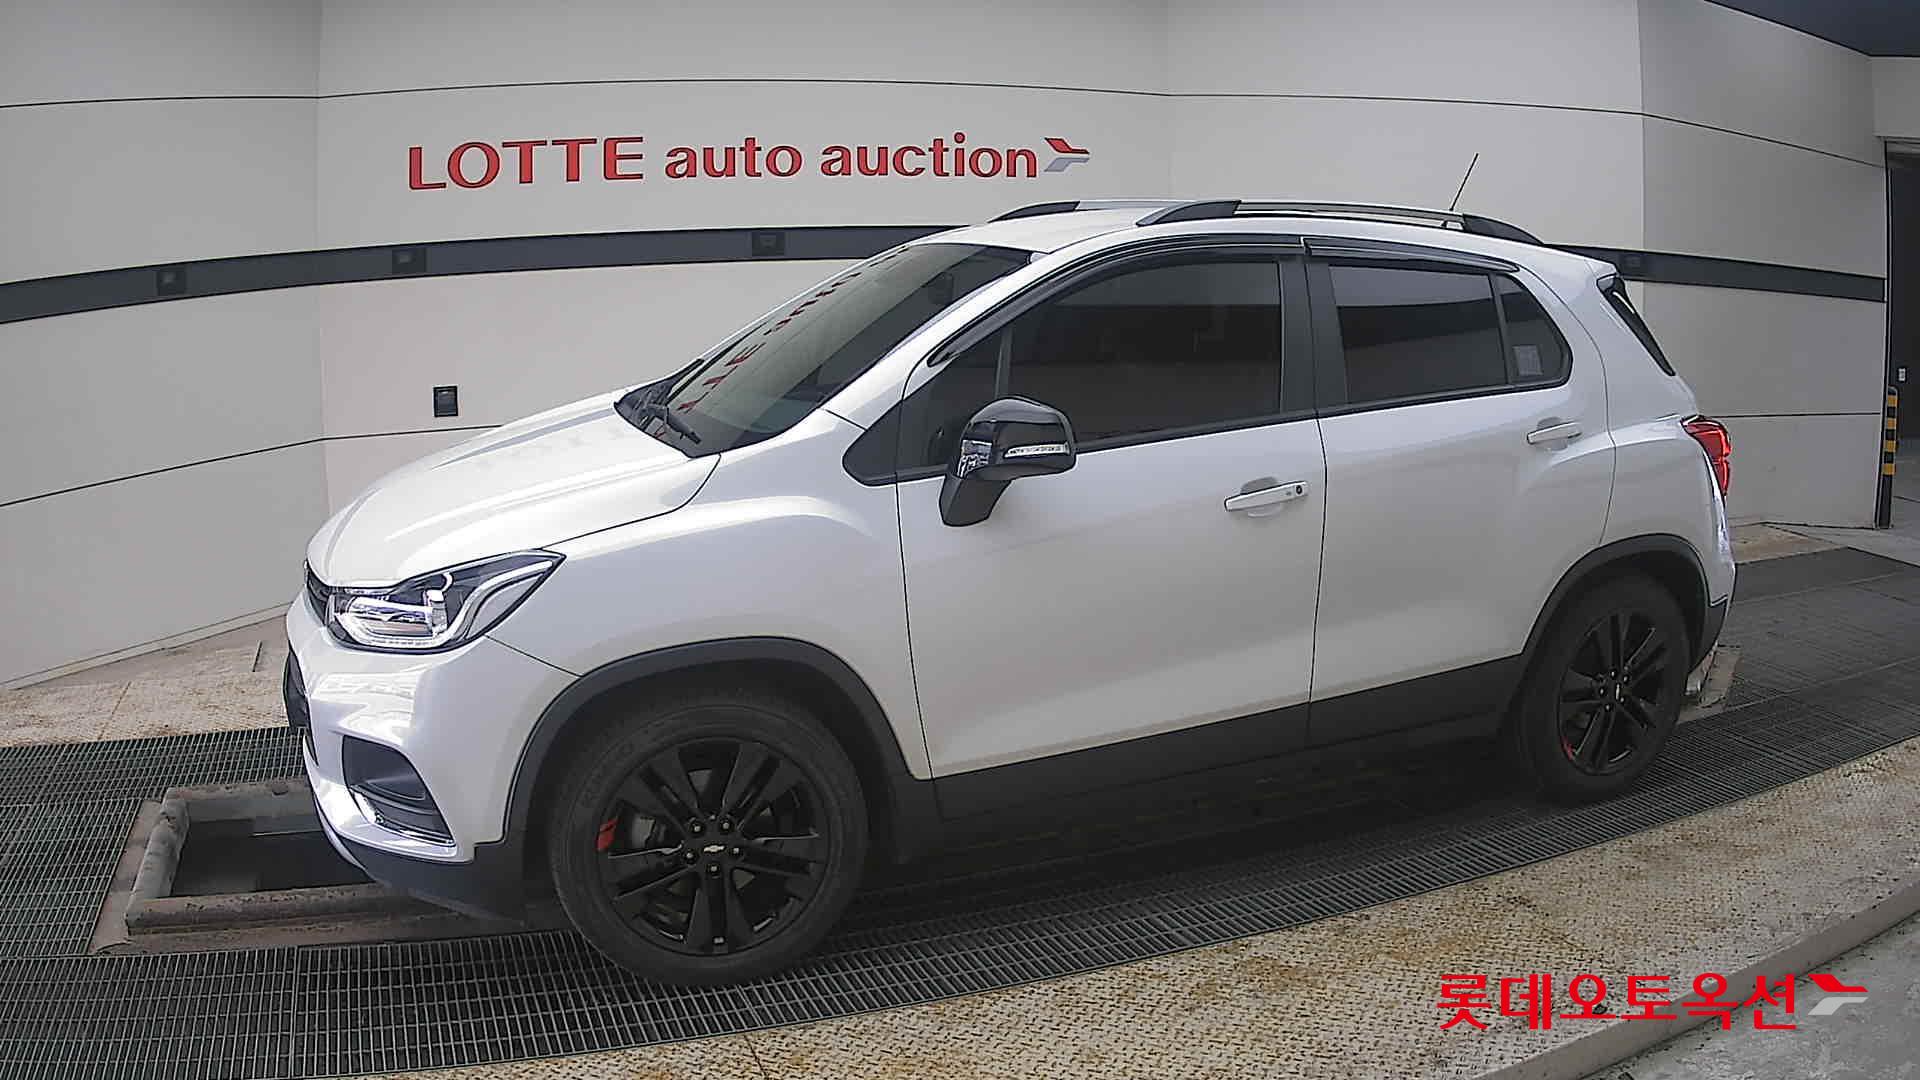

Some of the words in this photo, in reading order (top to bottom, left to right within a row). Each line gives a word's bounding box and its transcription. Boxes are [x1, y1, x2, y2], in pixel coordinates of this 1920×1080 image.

[409, 137, 645, 190] LOTTE
[664, 138, 803, 180] auto
[821, 132, 1037, 179] auction
